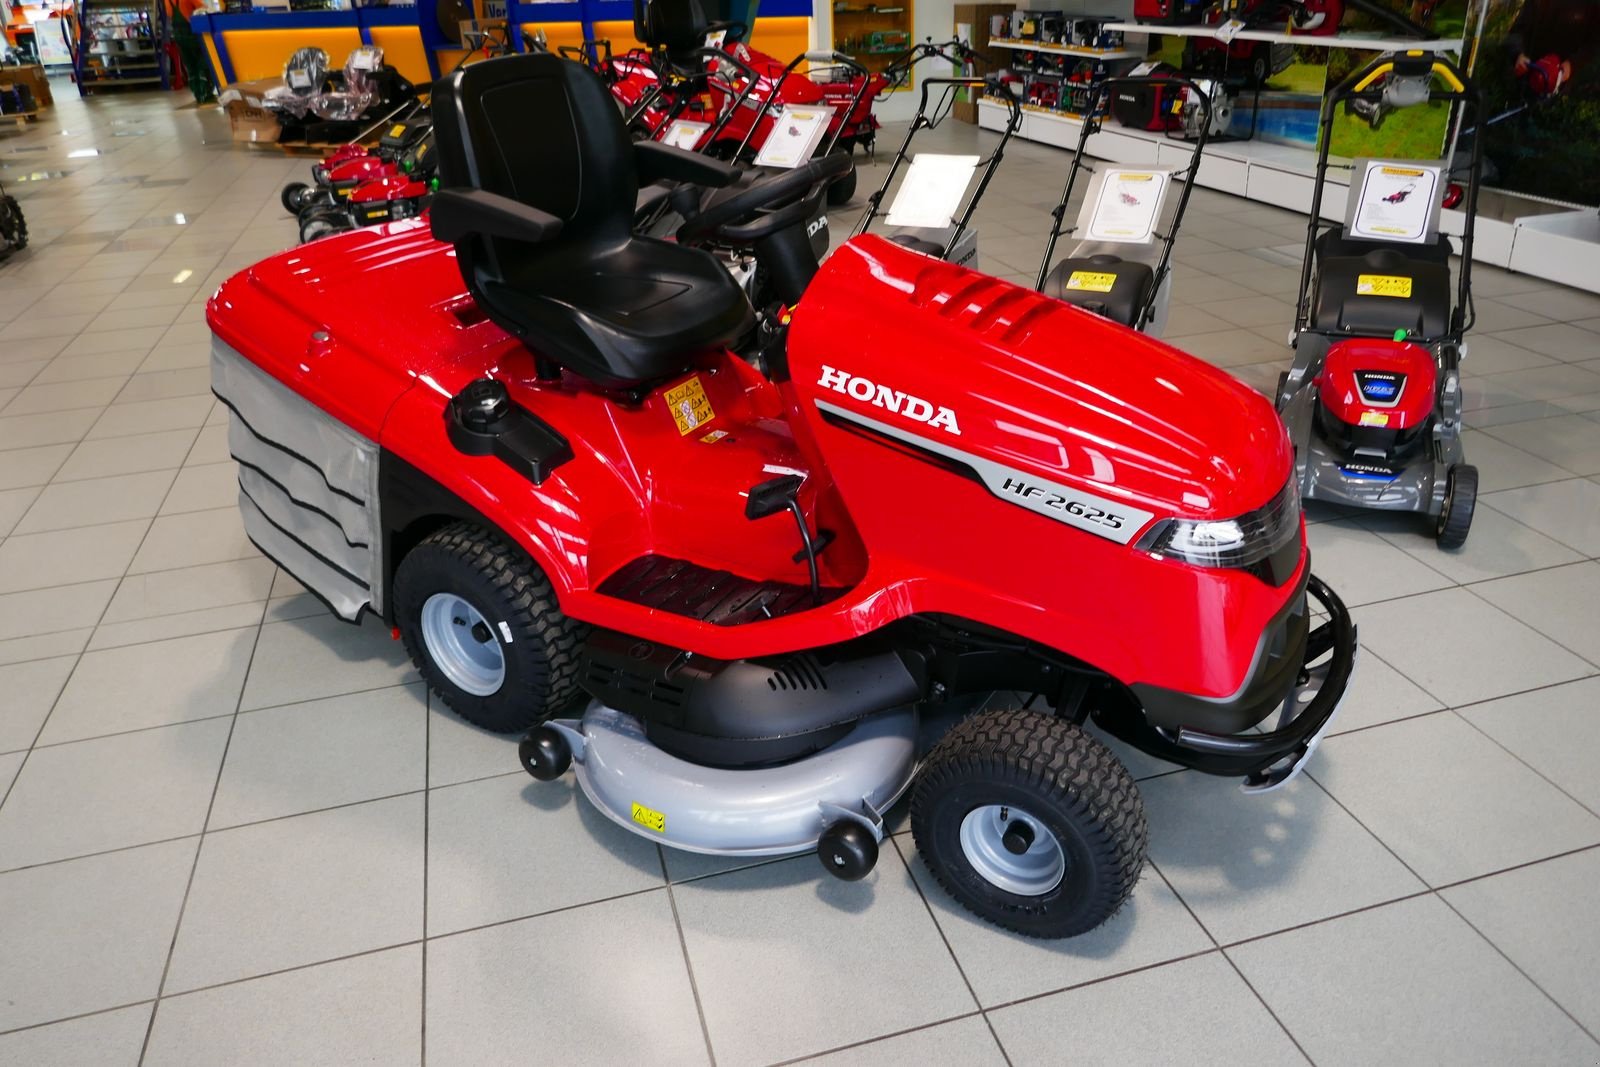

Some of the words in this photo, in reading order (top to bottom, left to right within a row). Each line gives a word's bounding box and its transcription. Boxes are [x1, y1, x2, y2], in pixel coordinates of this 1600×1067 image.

[1364, 373, 1396, 381] HONDA
[817, 364, 962, 436] HONDA
[1345, 463, 1393, 474] HONDA
[1001, 477, 1046, 498] HF
[1045, 492, 1125, 530] 2625
